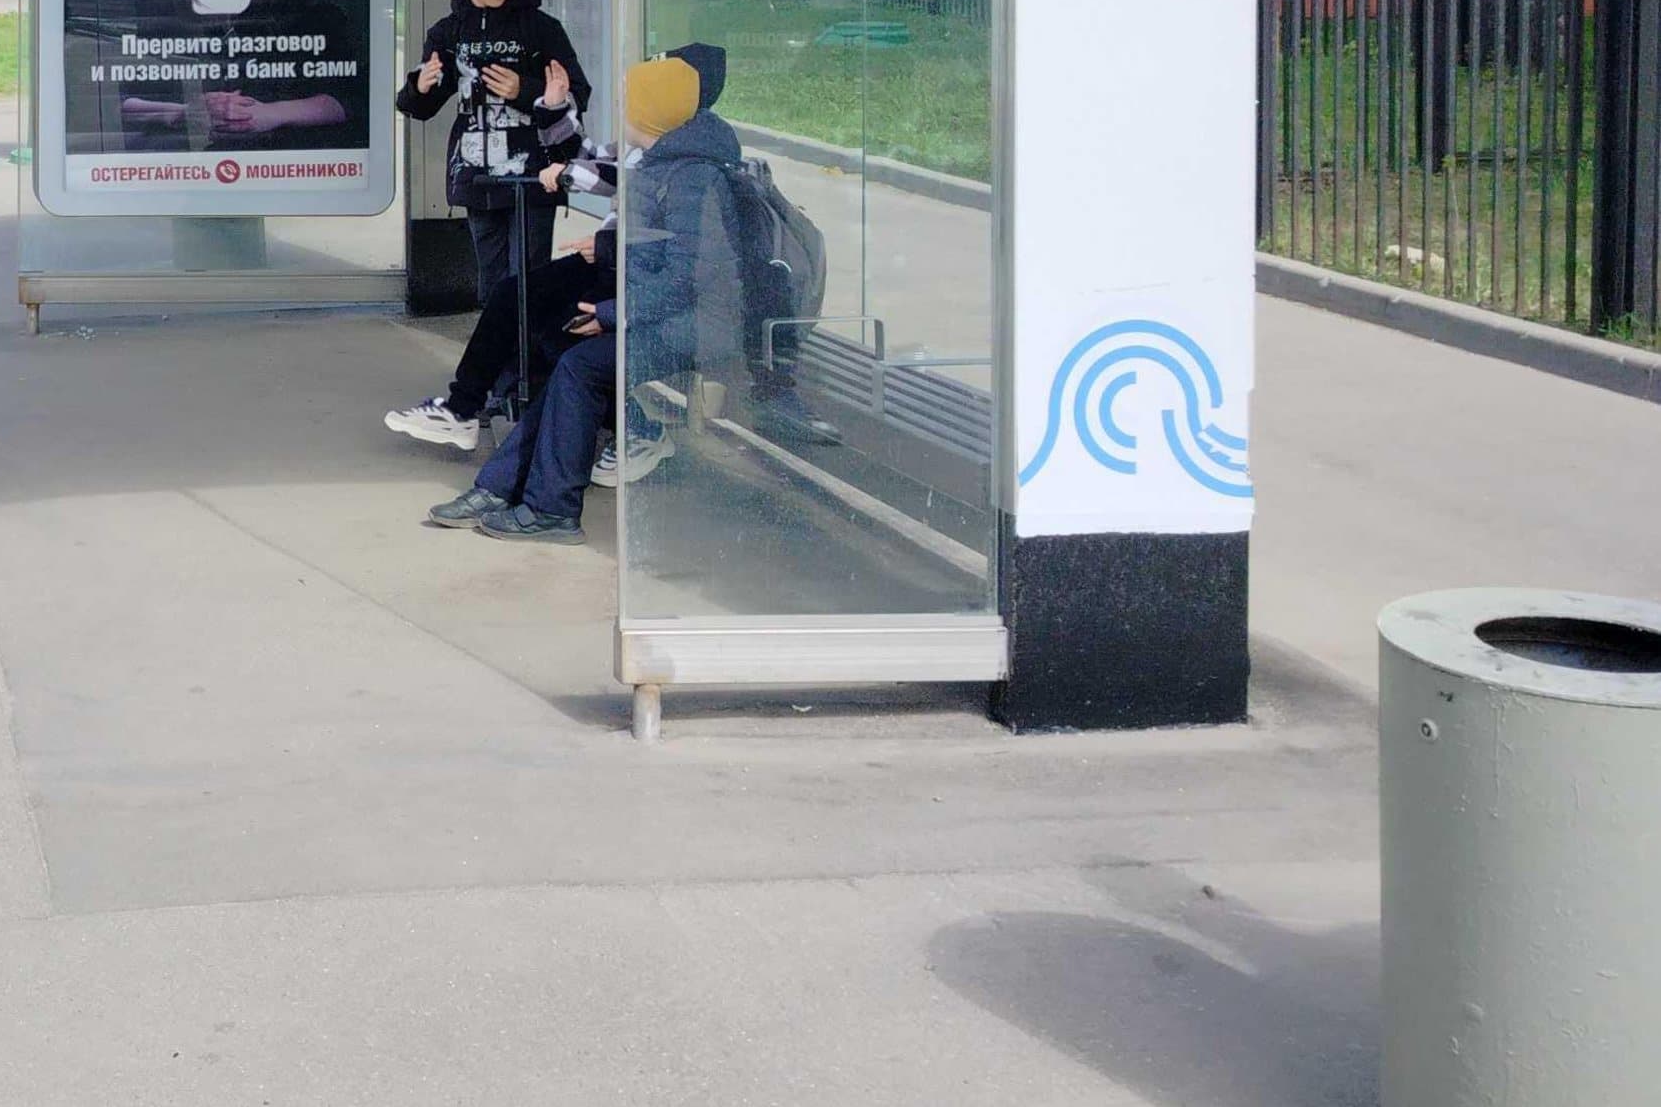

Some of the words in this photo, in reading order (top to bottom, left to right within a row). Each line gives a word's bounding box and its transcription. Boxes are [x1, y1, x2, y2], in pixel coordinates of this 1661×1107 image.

[121, 34, 222, 59] Прервите
[227, 34, 326, 58] разговор
[91, 66, 104, 82] и
[110, 63, 221, 81] позвоните
[227, 63, 239, 79] в
[245, 58, 296, 79] банк
[302, 60, 358, 78] сами
[91, 163, 211, 183] ОСТЕРЕГАЙТЕСЬ
[245, 162, 364, 180] МОШЕННИКОВ!
